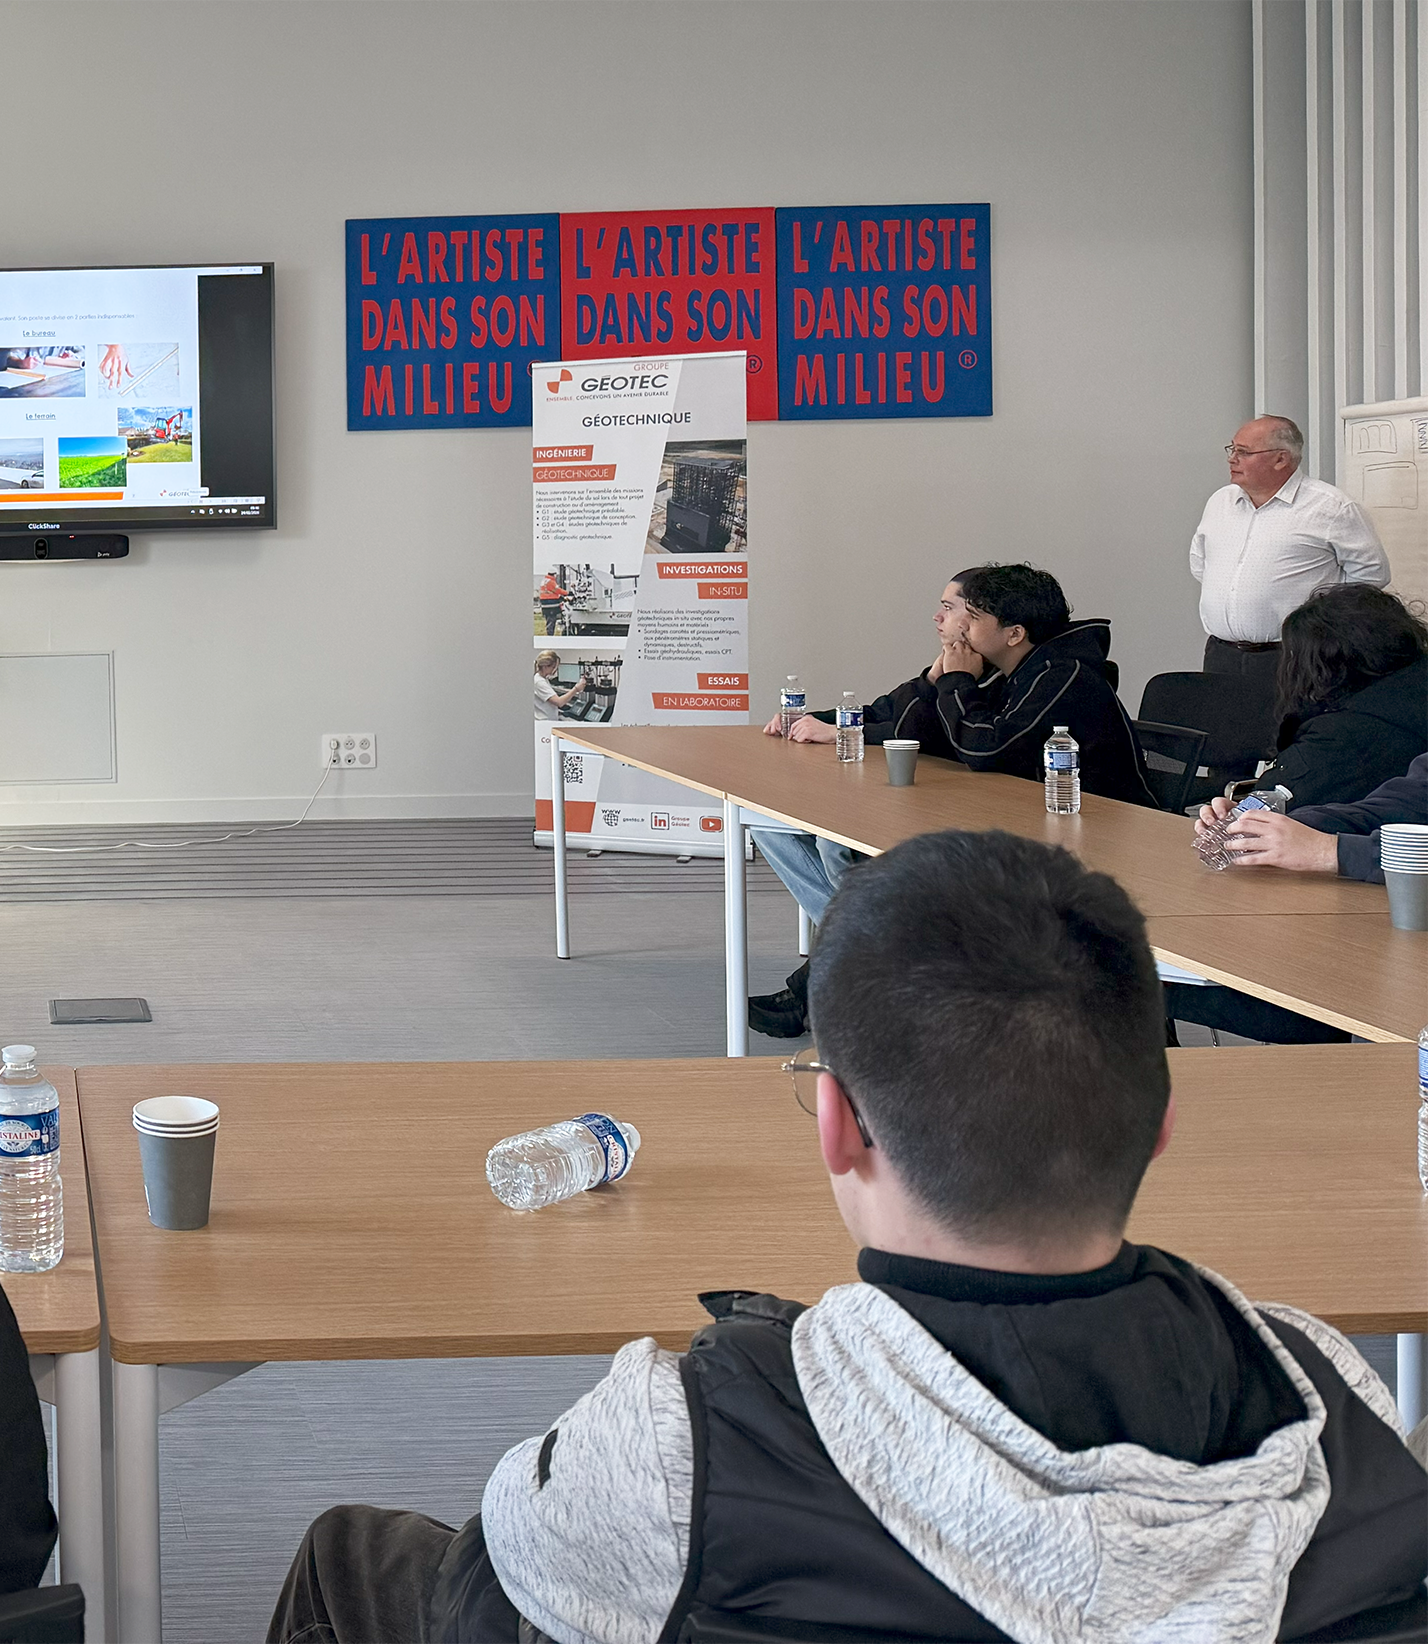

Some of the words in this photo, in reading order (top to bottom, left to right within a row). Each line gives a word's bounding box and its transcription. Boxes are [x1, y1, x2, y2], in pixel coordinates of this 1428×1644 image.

[361, 228, 544, 285] L'ARTISTE
[576, 223, 761, 279] L'ARTISTE
[793, 218, 976, 273] L'ARTISTE
[362, 296, 458, 350] DANS
[471, 295, 545, 349] SON
[576, 290, 673, 345] DANS
[687, 289, 761, 342] SON
[794, 285, 890, 339] DANS
[903, 285, 977, 338] SON
[634, 362, 669, 371] GROUPE
[794, 351, 944, 405] MILIEU
[363, 362, 512, 416] MILIEU
[582, 412, 691, 427] GÉOTECHNIQUE
[536, 449, 587, 458] INGÉNIERIE
[536, 468, 609, 480] GÉOTECHNIQUE
[663, 566, 743, 574] INVESTIGATIONS
[709, 587, 742, 595] IN-SITU
[708, 677, 740, 685] ESSAIS
[663, 697, 677, 706] EN
[679, 697, 741, 707] LABORATOIRE
